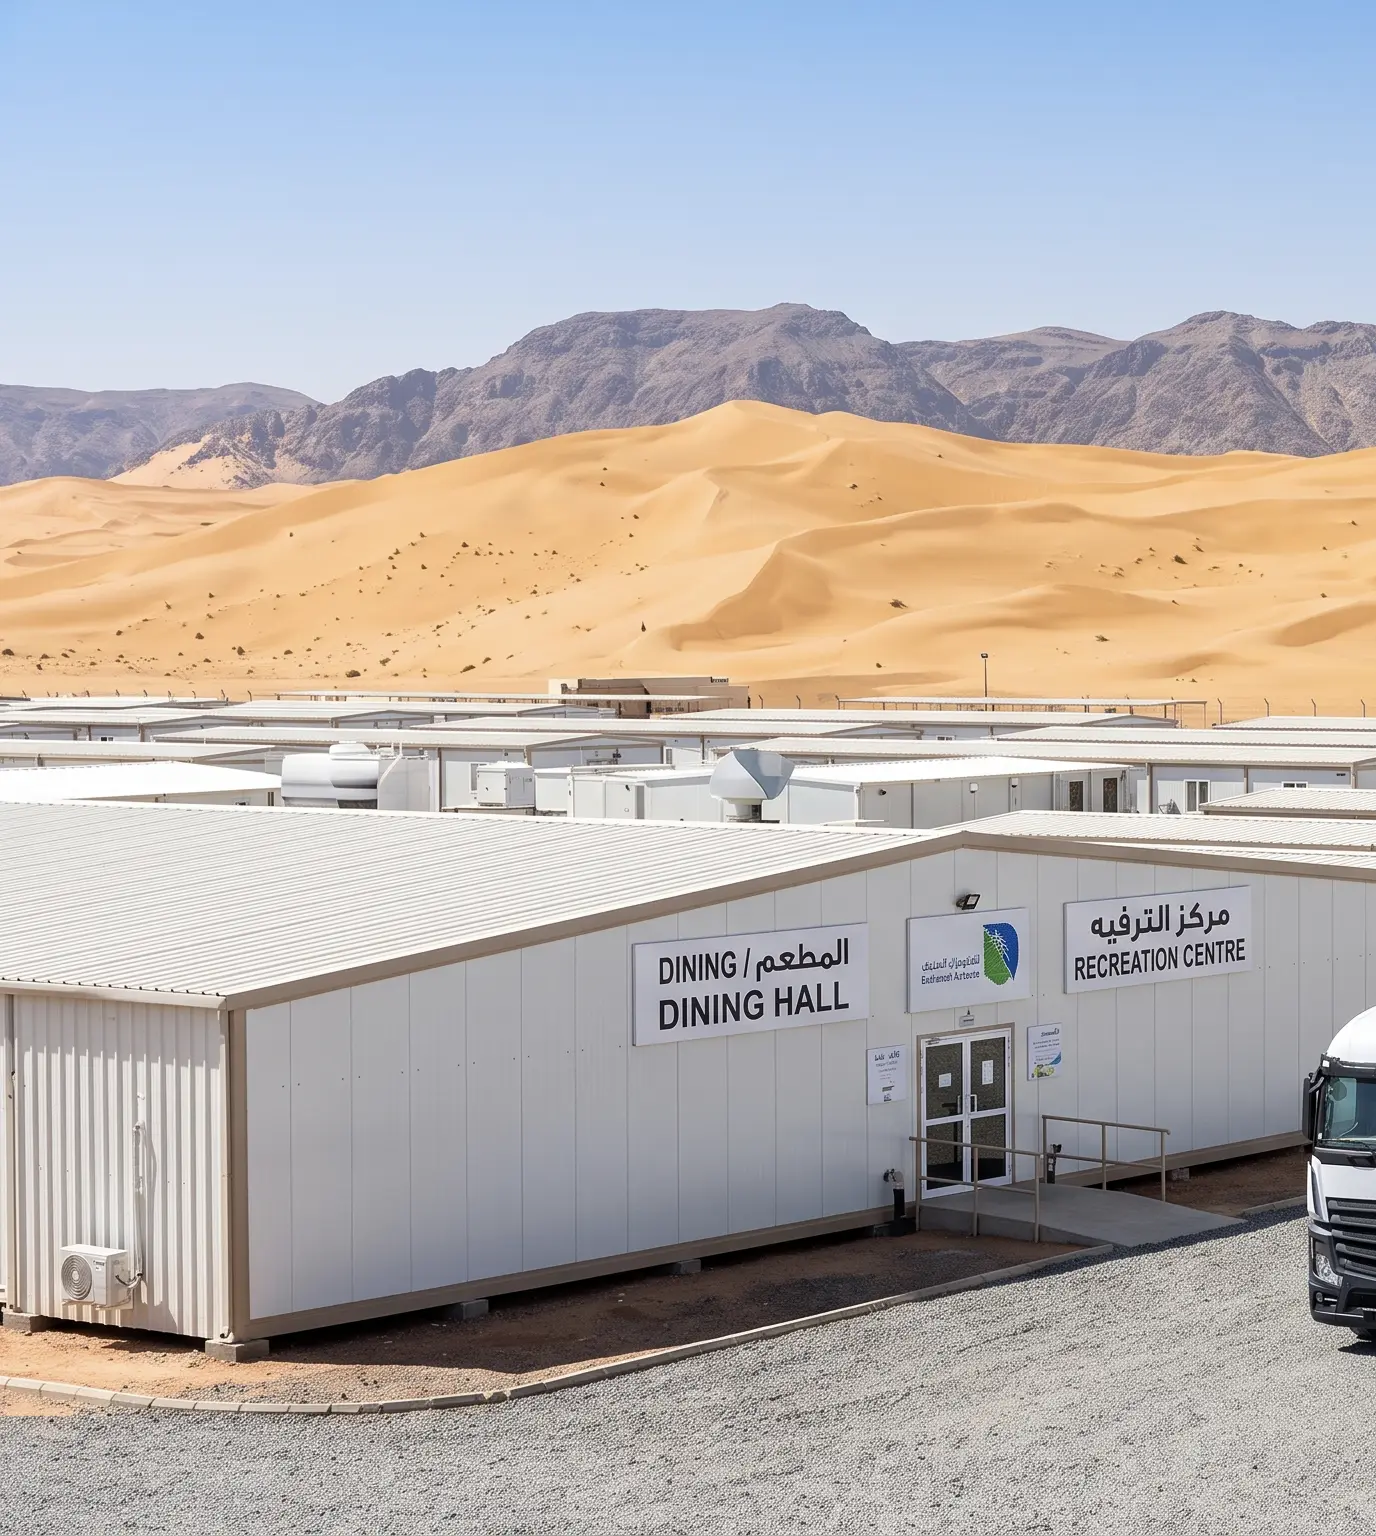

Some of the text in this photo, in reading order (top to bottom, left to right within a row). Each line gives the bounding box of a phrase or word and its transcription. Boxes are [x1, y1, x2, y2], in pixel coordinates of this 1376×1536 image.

[1090, 902, 1230, 945] مركز الترفيه
[659, 950, 737, 985] DINING
[756, 937, 849, 982] المطعم
[1074, 938, 1246, 981] RECREATION CENTRE
[659, 981, 850, 1031] DINING HALL
